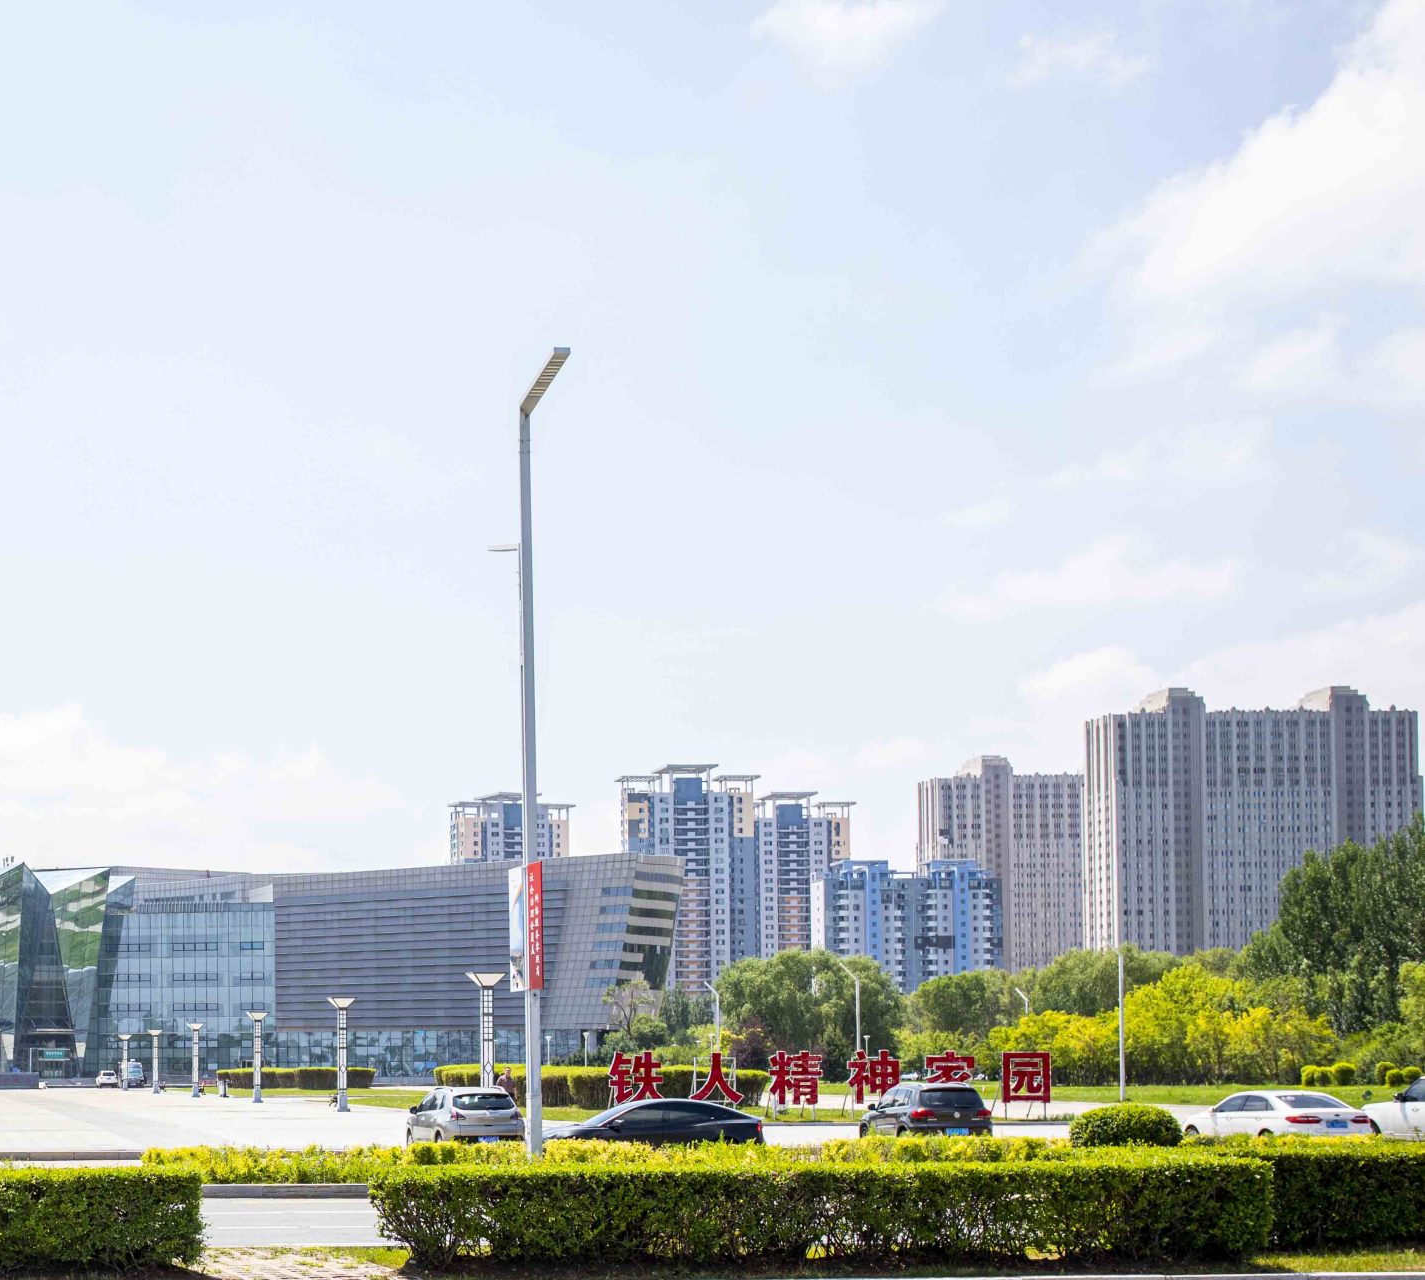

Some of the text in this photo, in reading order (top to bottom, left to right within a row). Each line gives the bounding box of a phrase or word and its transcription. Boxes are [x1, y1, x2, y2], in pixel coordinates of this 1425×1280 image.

[608, 1049, 1051, 1105] 铁人精神家园
